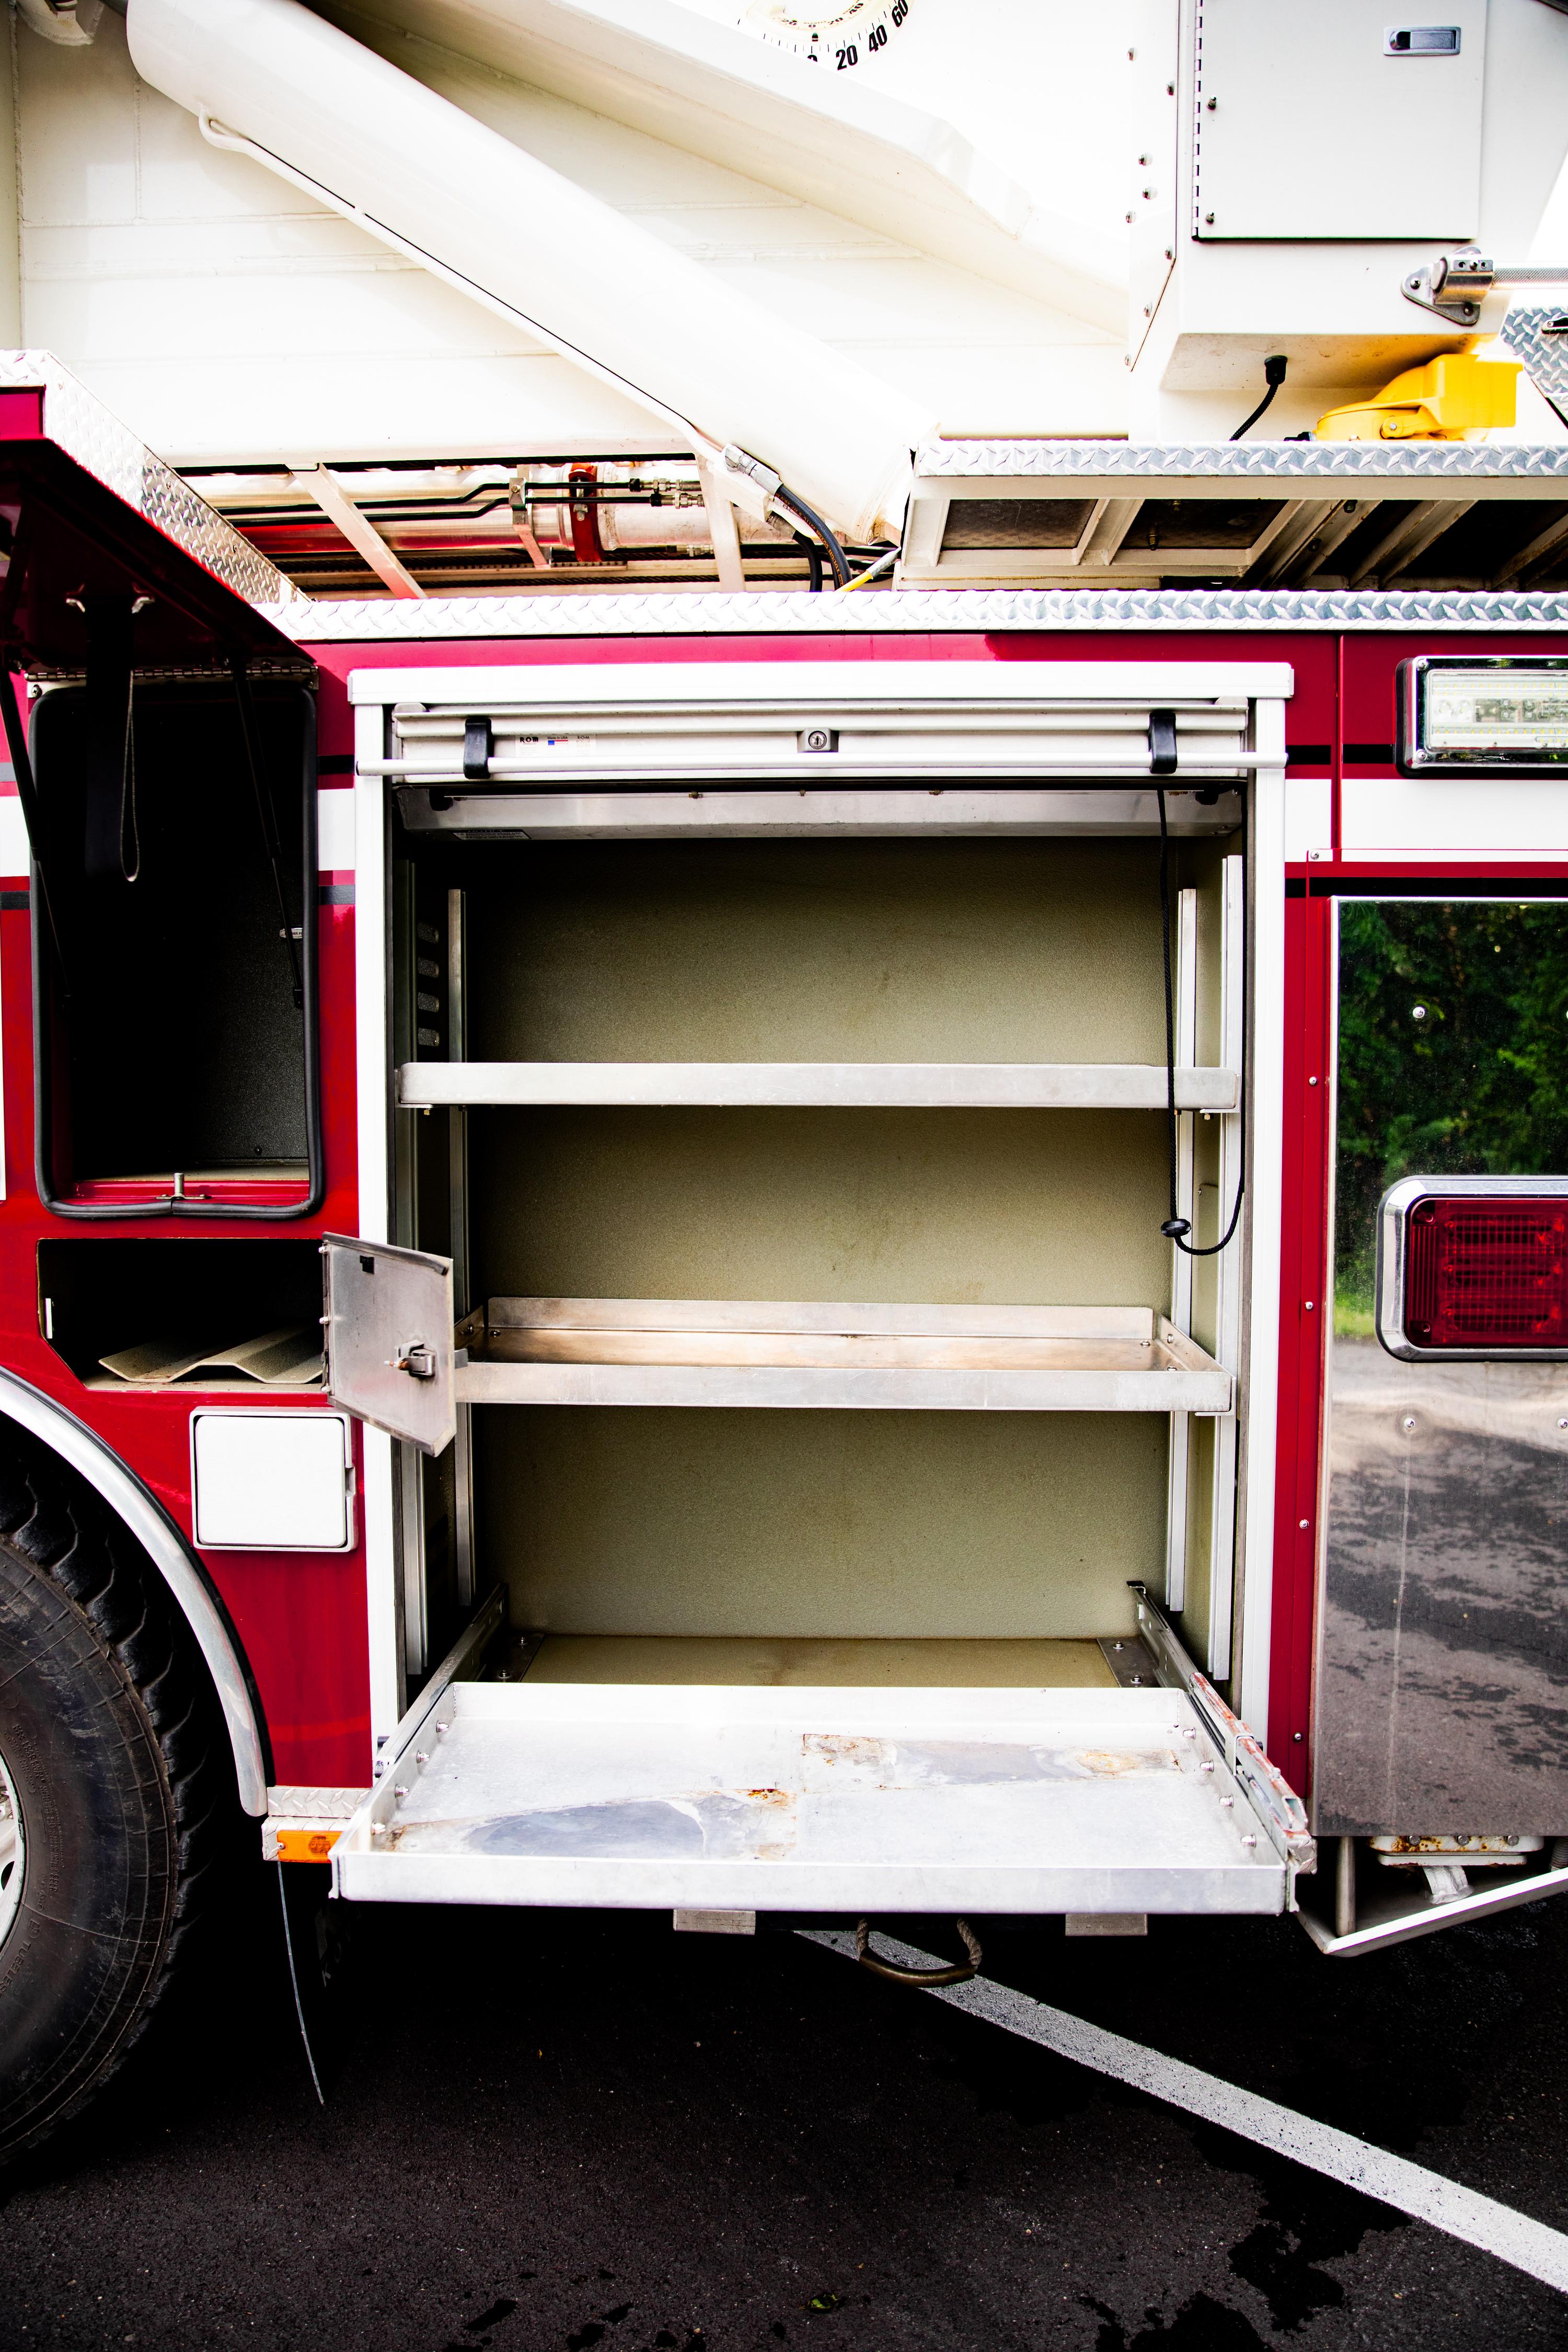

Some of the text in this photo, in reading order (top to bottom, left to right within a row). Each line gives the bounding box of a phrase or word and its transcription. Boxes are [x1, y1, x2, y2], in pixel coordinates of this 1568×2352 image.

[892, 0, 908, 27] 60
[869, 25, 887, 52] 40
[836, 45, 858, 71] 20
[816, 529, 828, 549] COVER
